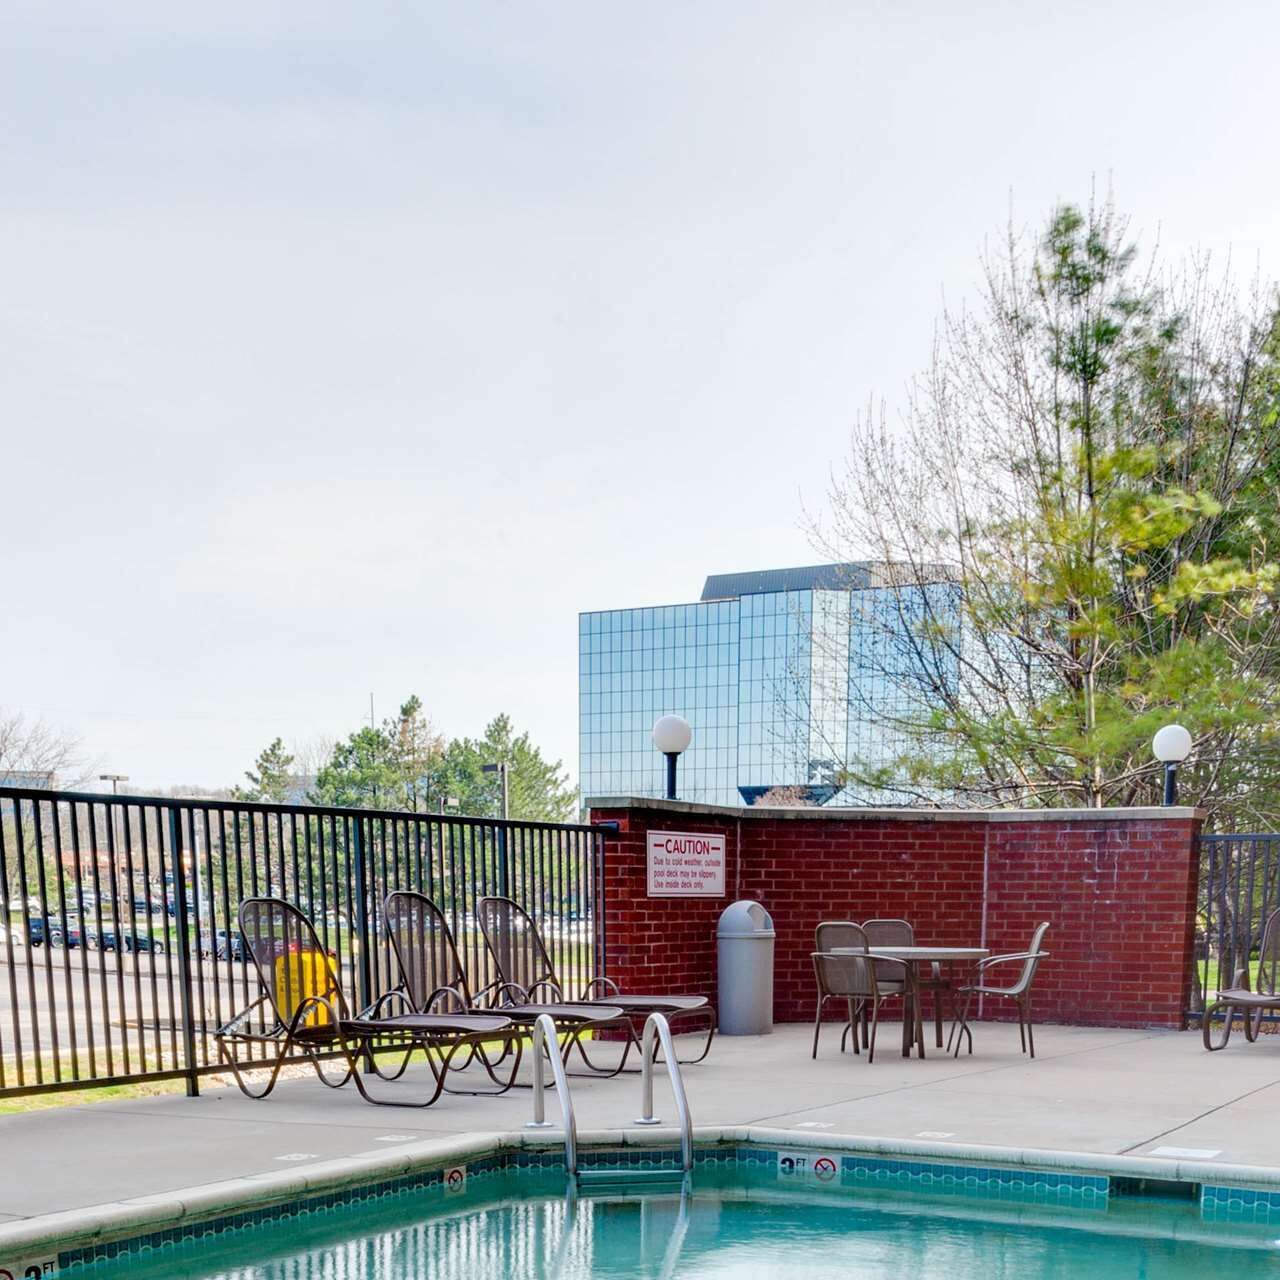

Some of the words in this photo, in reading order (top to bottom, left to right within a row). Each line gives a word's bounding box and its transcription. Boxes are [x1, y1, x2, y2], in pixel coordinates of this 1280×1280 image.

[665, 839, 710, 854] CAUTION
[654, 856, 664, 865] Due
[666, 857, 670, 865] to
[672, 858, 682, 866] cold
[704, 859, 721, 867] outside
[654, 870, 664, 878] pool
[666, 870, 678, 878] deck
[691, 870, 698, 878] be
[654, 880, 664, 888] Use
[796, 1158, 806, 1167] FT
[43, 1261, 55, 1274] FT
